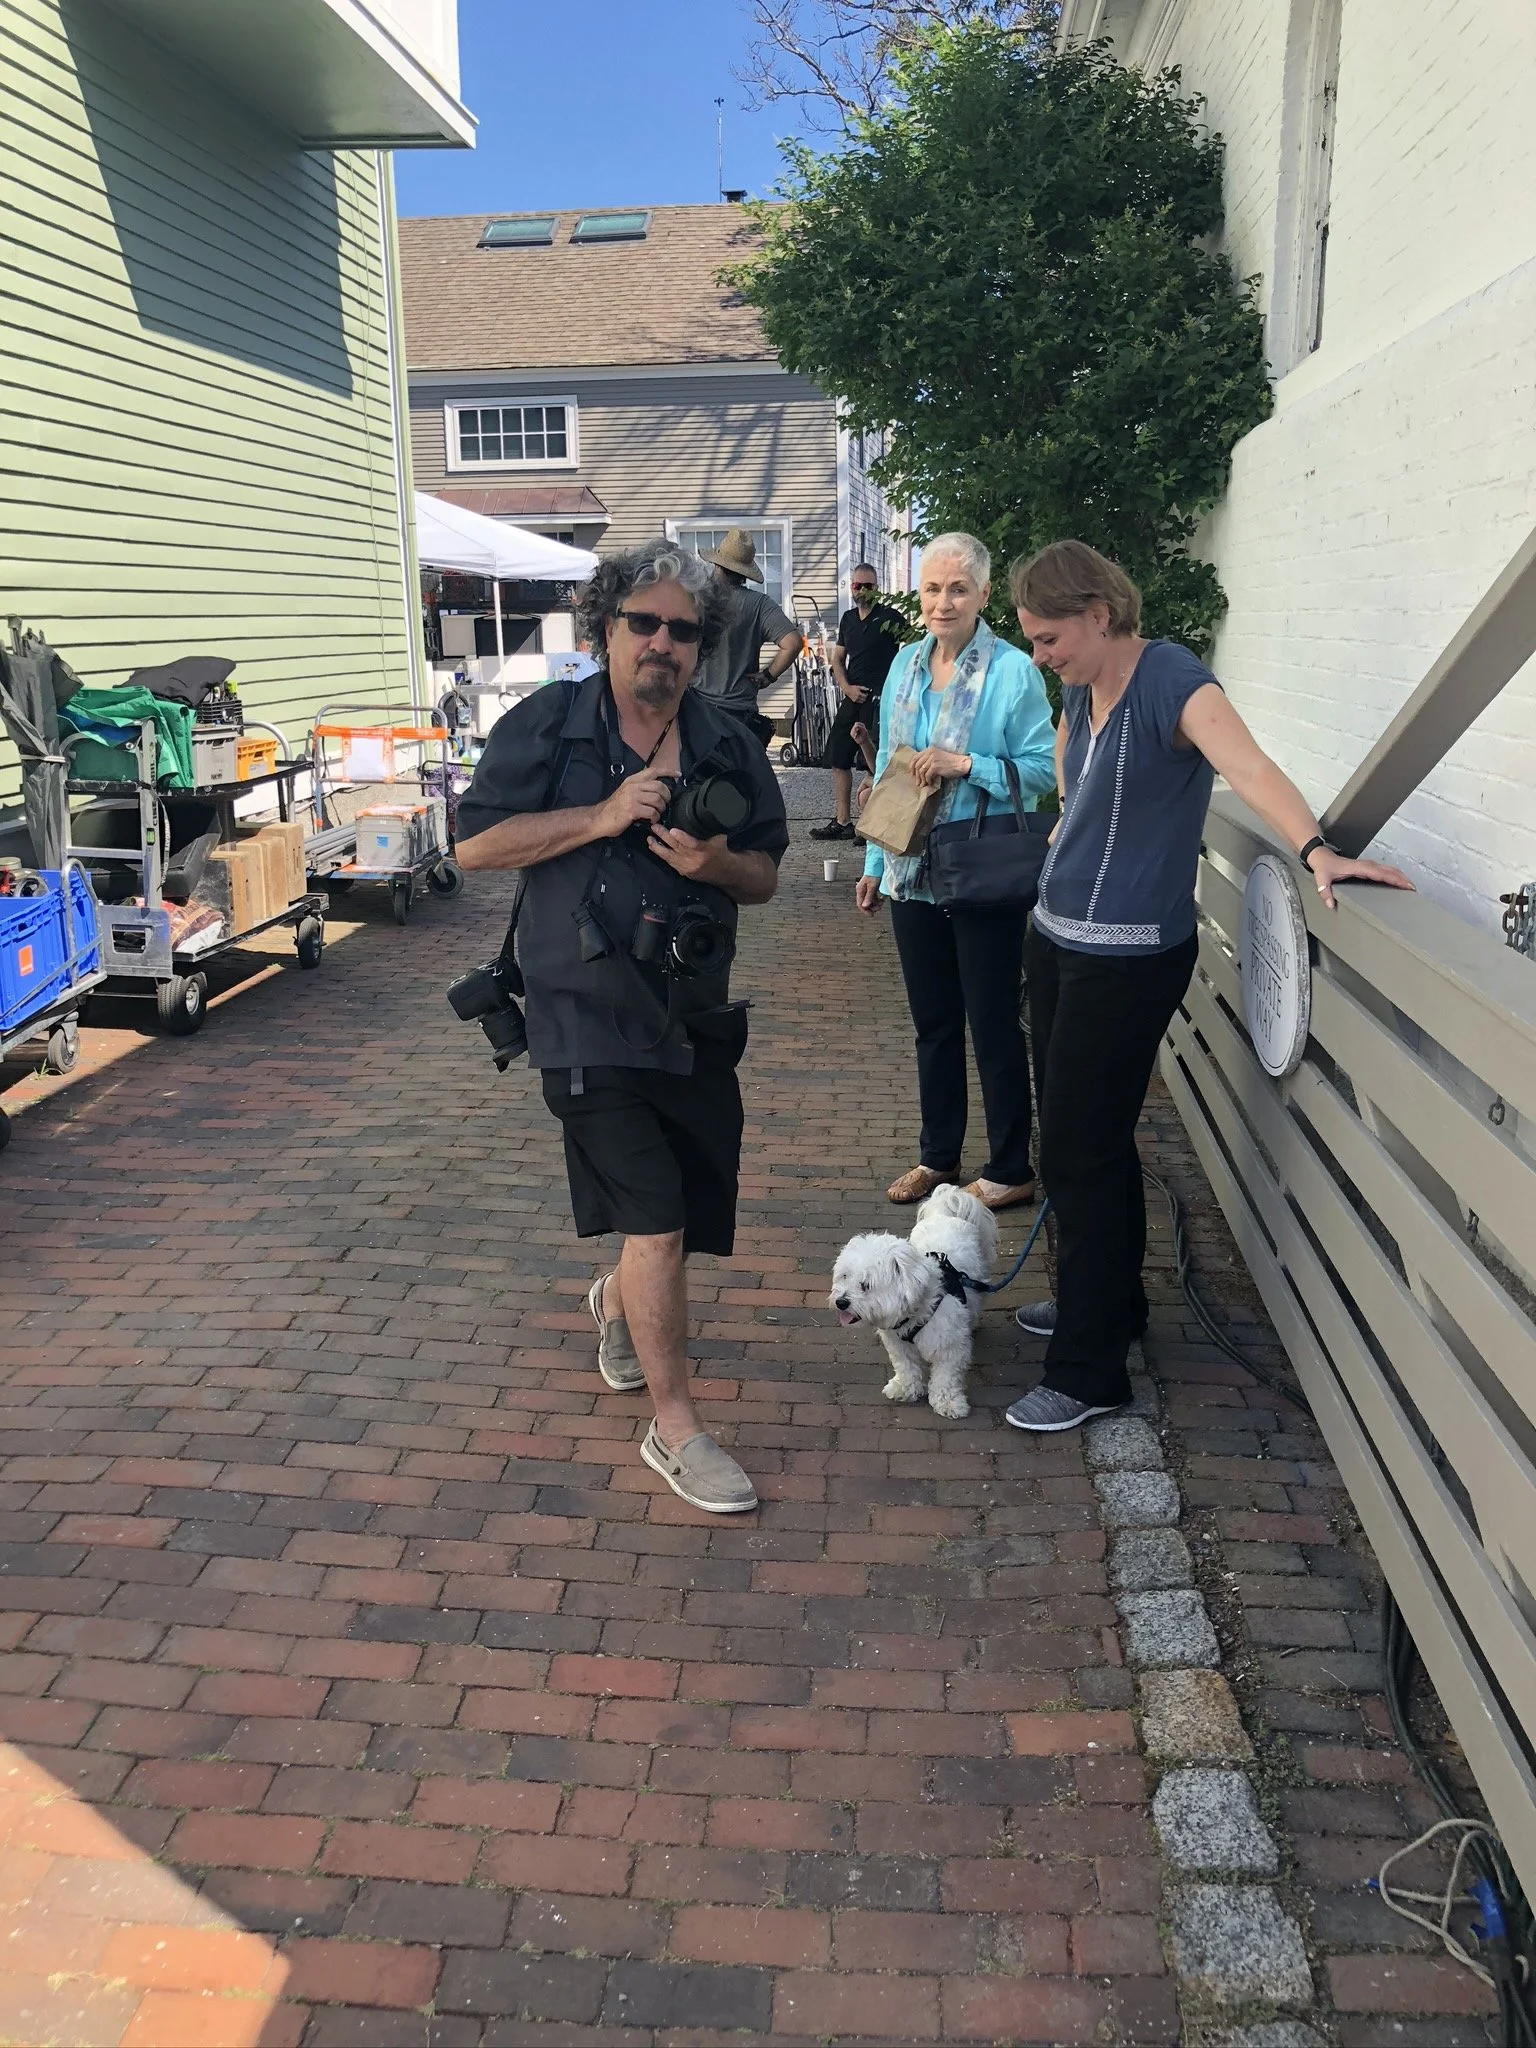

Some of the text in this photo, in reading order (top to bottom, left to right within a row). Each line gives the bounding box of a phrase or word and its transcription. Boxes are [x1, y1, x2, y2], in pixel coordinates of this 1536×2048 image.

[841, 579, 846, 588] 9
[1262, 893, 1273, 927] NO
[1247, 907, 1290, 980] TRESPASSING
[1250, 950, 1282, 1019] PRIVATE
[1255, 992, 1274, 1044] WAY
